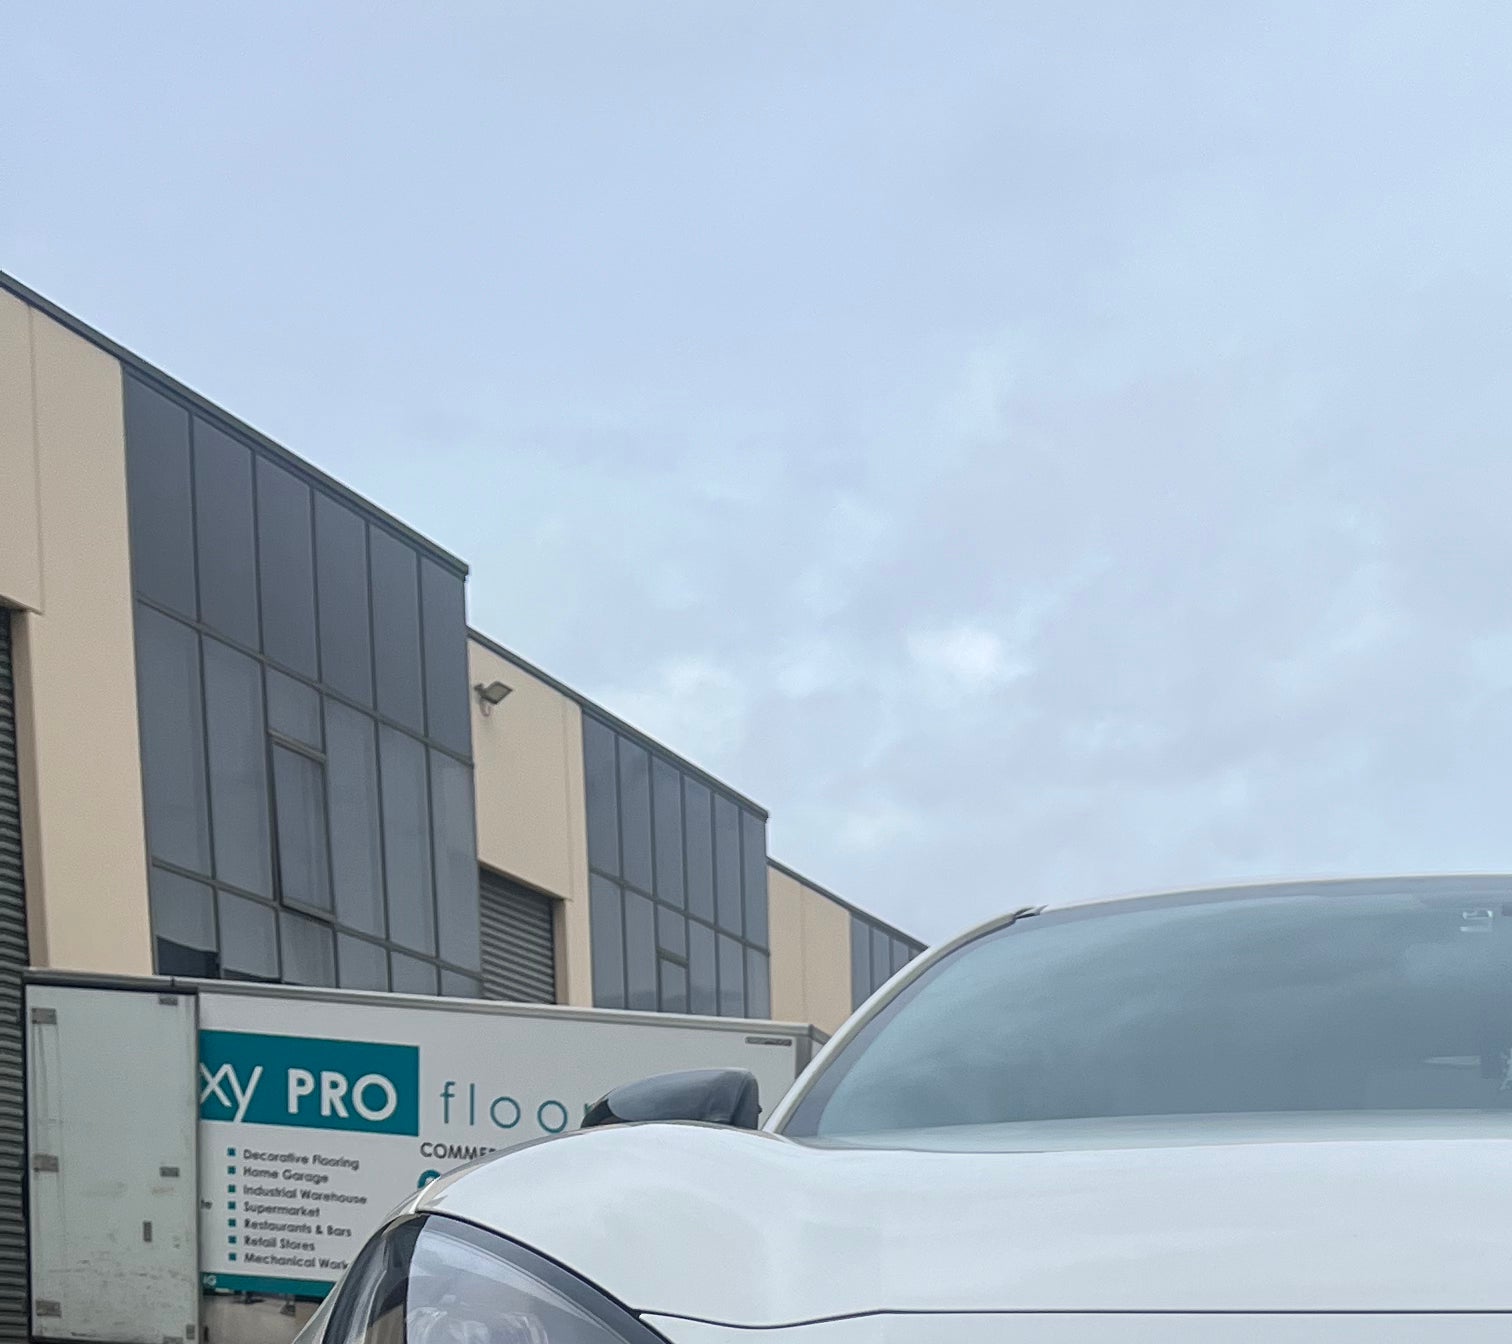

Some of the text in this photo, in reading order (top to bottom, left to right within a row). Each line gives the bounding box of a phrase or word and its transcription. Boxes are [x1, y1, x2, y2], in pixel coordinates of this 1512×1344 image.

[287, 1067, 397, 1121] PRO
[243, 1149, 359, 1170] Decorative Flooring
[243, 1166, 329, 1184] Home Garage
[243, 1185, 367, 1204] Industrial Warehouse
[243, 1201, 320, 1217] Supermarket
[244, 1219, 351, 1237] Restaurants & Bars
[244, 1236, 315, 1251] Retail Stores
[244, 1253, 315, 1267] Mechanical
